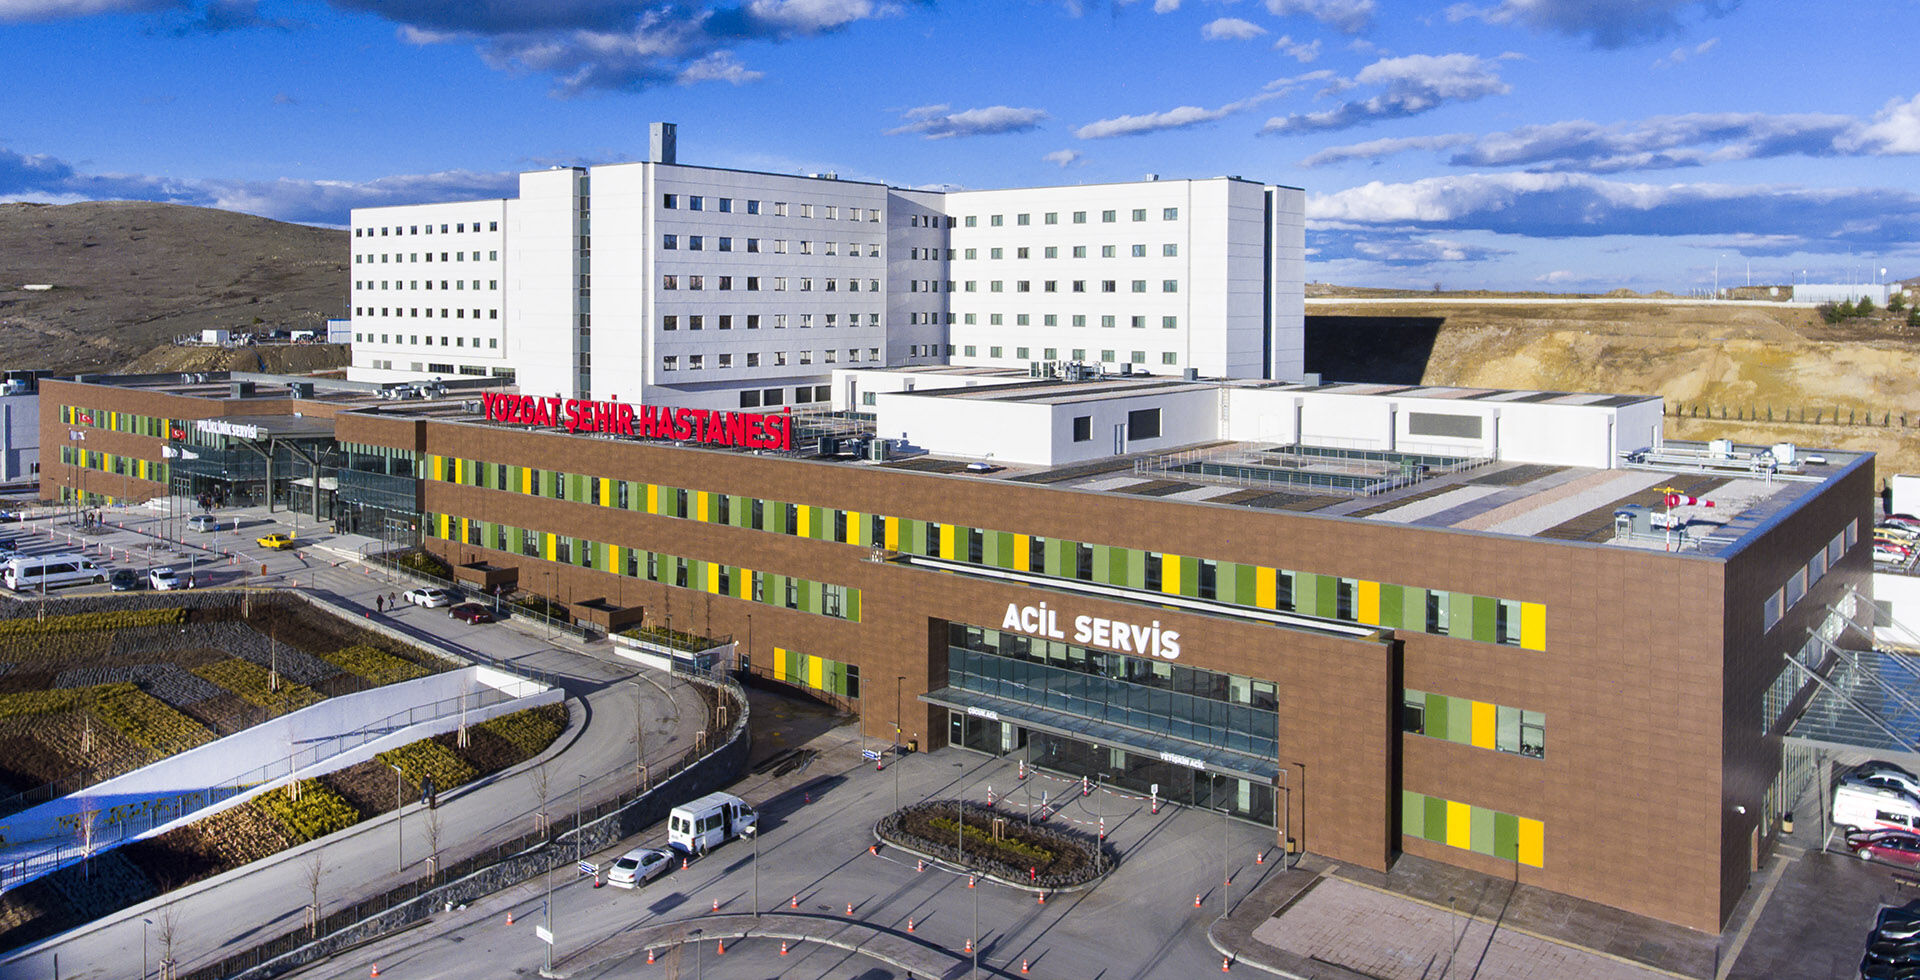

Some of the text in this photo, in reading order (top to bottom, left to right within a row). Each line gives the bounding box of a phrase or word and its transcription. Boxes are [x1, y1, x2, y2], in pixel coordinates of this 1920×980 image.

[481, 392, 792, 451] YOZGAT ŞEHİR HASTANESİ
[1002, 601, 1181, 660] ACİL SERVİS
